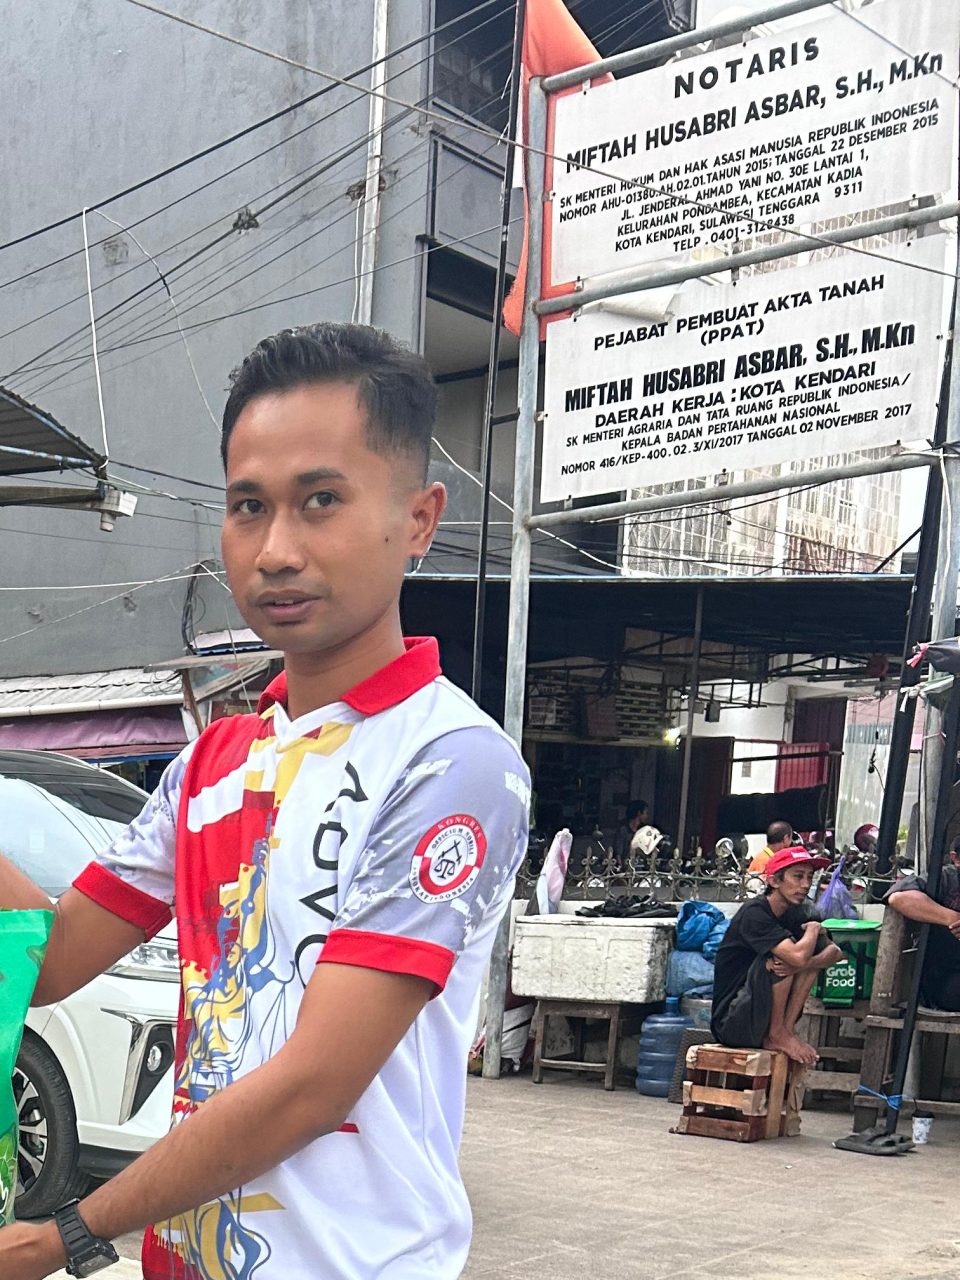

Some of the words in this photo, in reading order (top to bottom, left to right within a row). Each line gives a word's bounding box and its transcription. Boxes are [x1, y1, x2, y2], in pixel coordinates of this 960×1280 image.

[674, 37, 818, 98] NOTARIS
[566, 134, 636, 173] MIFTAH
[645, 105, 736, 150] HUSABRI
[744, 84, 825, 124] ASBAR,
[835, 69, 883, 99] S.H.,
[889, 53, 942, 84] M.Kn
[559, 203, 596, 222] NOMOR
[774, 143, 825, 165] TANGGAL
[830, 138, 844, 151] 22
[848, 121, 907, 146] DESEMBER
[912, 113, 938, 130] 2015
[560, 195, 572, 208] SK
[575, 183, 616, 203] MENTERI
[620, 172, 654, 191] HUKUM
[658, 165, 680, 181] DAN
[684, 158, 707, 174] HAK
[713, 148, 745, 167] ASASI
[749, 134, 802, 158] MANUSIA
[808, 117, 865, 143] REPUBLIK
[871, 98, 938, 126] INDONESIA
[621, 208, 634, 221] JL.
[639, 192, 692, 216] JENDERAL
[696, 182, 733, 204] AHMAD
[738, 175, 761, 190] YANI
[766, 170, 784, 184] NO.
[789, 162, 808, 178] 30E
[813, 152, 853, 173] LANTAI
[860, 148, 868, 161] 1,
[615, 235, 641, 251] KOTA
[645, 223, 694, 244] KENDARI,
[699, 207, 753, 230] SULAWESI
[758, 191, 820, 216] TENGGARA
[834, 181, 862, 197] 9311
[617, 211, 678, 236] KELURAHAN
[682, 194, 751, 220] PONDAMBEA,
[756, 175, 821, 201] KECAMATAN
[827, 165, 862, 184] KADIA
[594, 321, 668, 350] PEJABAT
[676, 301, 758, 333] PEMBUAT
[763, 290, 812, 314] AKTA
[818, 274, 884, 301] TANAH
[700, 318, 764, 346] (PPAT)
[564, 377, 632, 412] MIFTAH
[642, 358, 725, 397] HUSABRI
[733, 343, 807, 379] ASBAR,
[861, 323, 914, 353] M.Kn
[595, 402, 664, 427] DAERAH
[671, 390, 725, 413] KERJA
[739, 379, 784, 400] KOTA
[794, 360, 875, 390] KENDARI
[561, 460, 595, 475] NOMOR
[746, 424, 797, 442] TANGGAL
[799, 421, 813, 433] 02
[815, 409, 878, 430] NOVEMBER
[884, 403, 911, 418] 2017
[566, 435, 577, 447] SK
[582, 427, 623, 444] MENTERI
[627, 418, 672, 436] AGRARIA
[677, 412, 700, 426] DAN
[706, 407, 729, 421] TATA
[735, 399, 772, 416] RUANG
[778, 387, 831, 407] REPUBLIK
[621, 431, 660, 451] KEPALA
[666, 426, 702, 442] BADAN
[707, 412, 777, 435] PERTAHANAN
[782, 401, 840, 422] NASIONAL
[437, 816, 480, 838] KONGRES
[826, 965, 856, 977] Grab
[826, 977, 856, 987] Food
